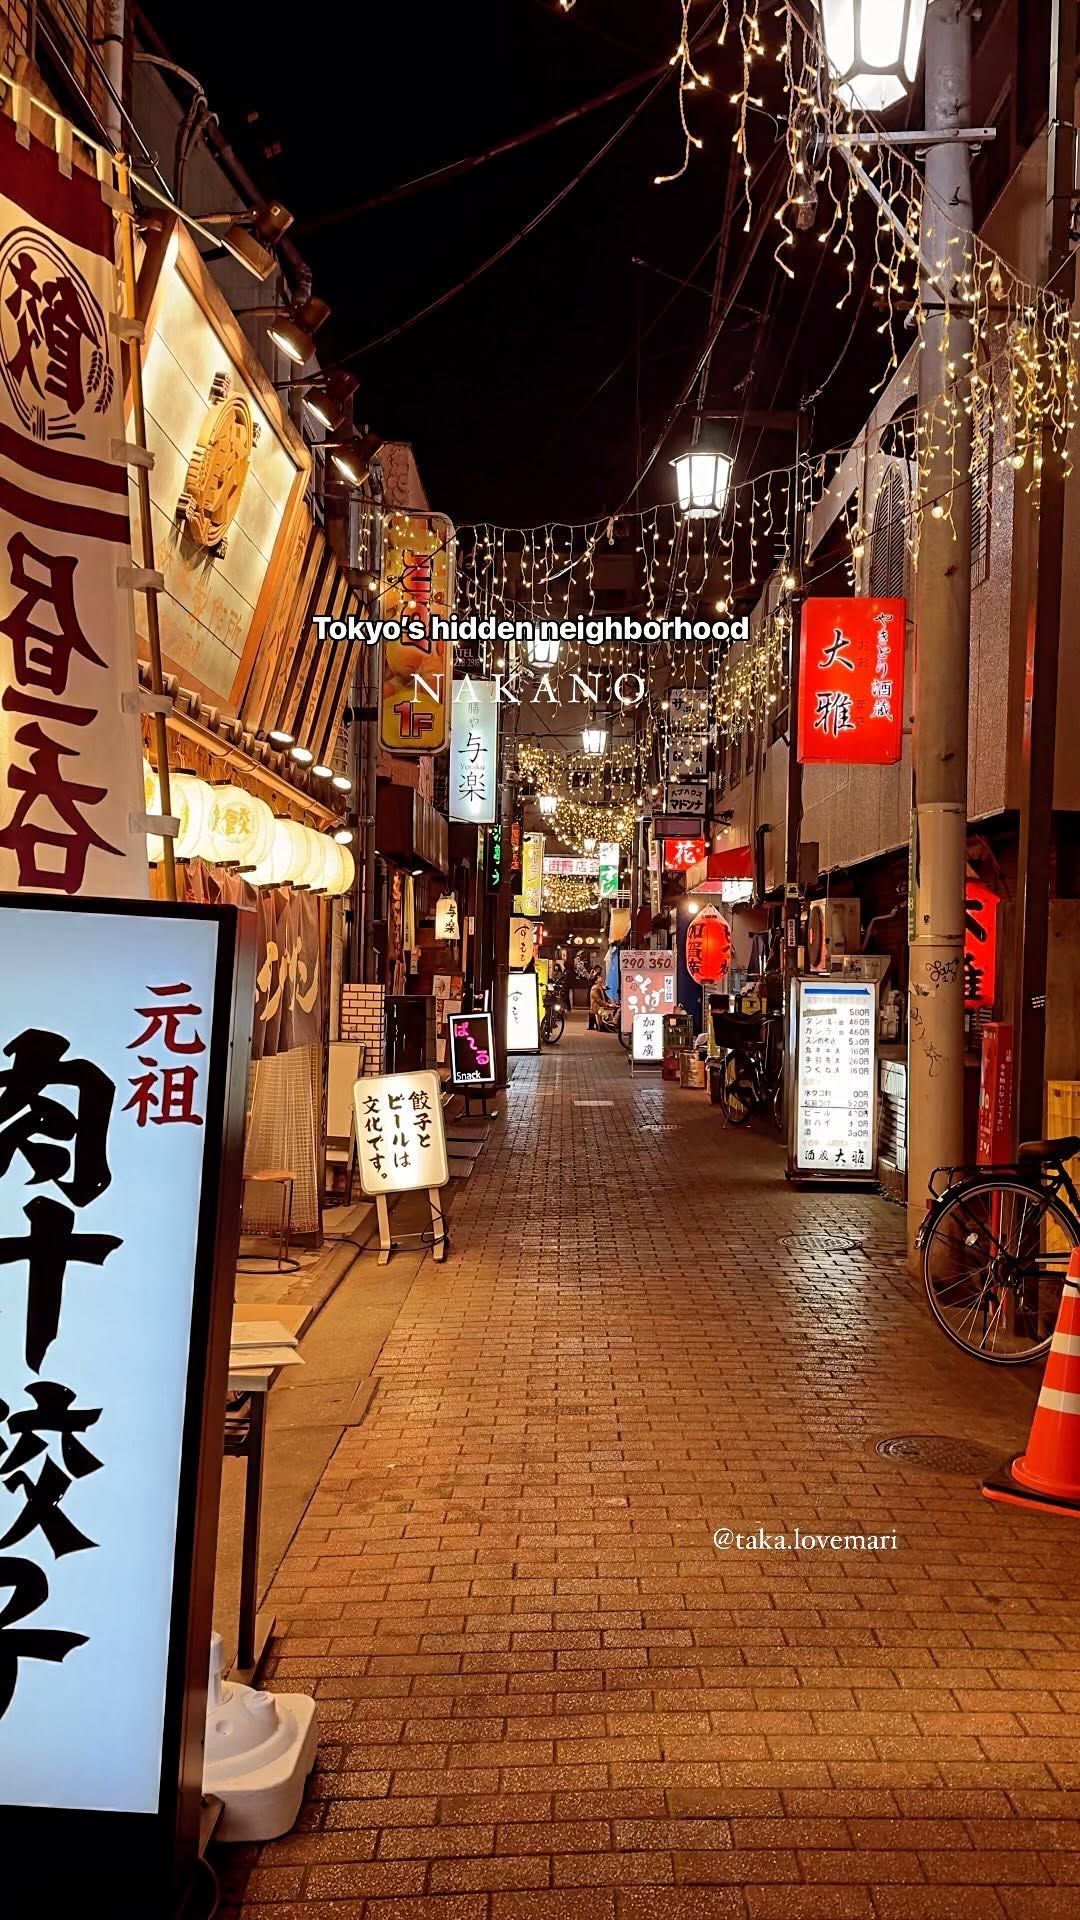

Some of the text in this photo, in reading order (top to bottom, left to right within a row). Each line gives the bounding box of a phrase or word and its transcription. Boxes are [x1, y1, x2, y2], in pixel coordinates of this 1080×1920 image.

[814, 628, 856, 737] 大雅
[870, 612, 894, 721] やきとり酒蔵
[393, 700, 435, 740] 1F
[457, 732, 489, 802] 与楽
[669, 799, 703, 811] マドンナ
[445, 904, 457, 934] 与楽
[121, 982, 206, 1127] 元祖
[456, 1070, 482, 1081] Snack
[362, 1095, 388, 1180] 文化です。
[387, 1093, 412, 1169] ビールは
[408, 1090, 433, 1148] 餃子と
[804, 1109, 831, 1117] ビール
